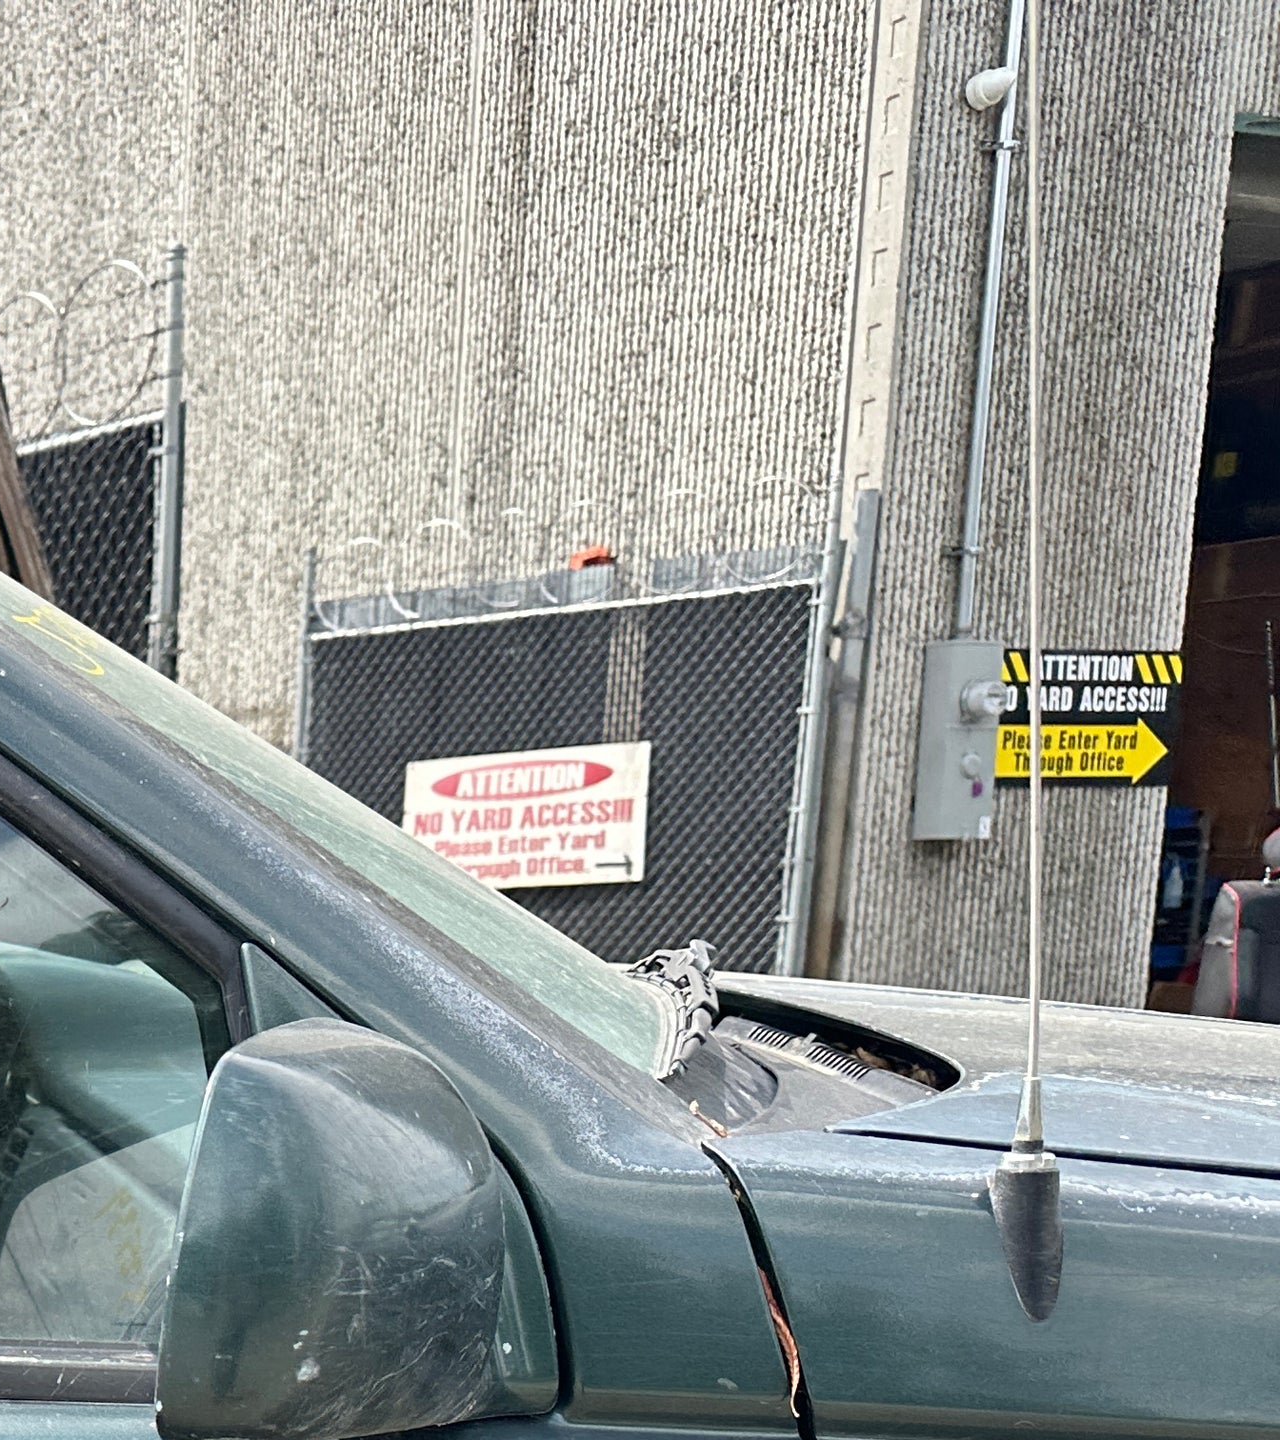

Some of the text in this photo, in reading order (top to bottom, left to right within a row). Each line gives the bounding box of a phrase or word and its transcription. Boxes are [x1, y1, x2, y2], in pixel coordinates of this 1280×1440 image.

[1080, 686, 1167, 712] ACCESS!!!
[1002, 730, 1138, 750] Pleae Enter Yard
[1014, 752, 1125, 774] Though Office
[456, 763, 586, 798] ATTENTION
[414, 798, 635, 837] NO YARD ACCESS!!!
[498, 834, 552, 854] Enter
[558, 830, 606, 850] Yard
